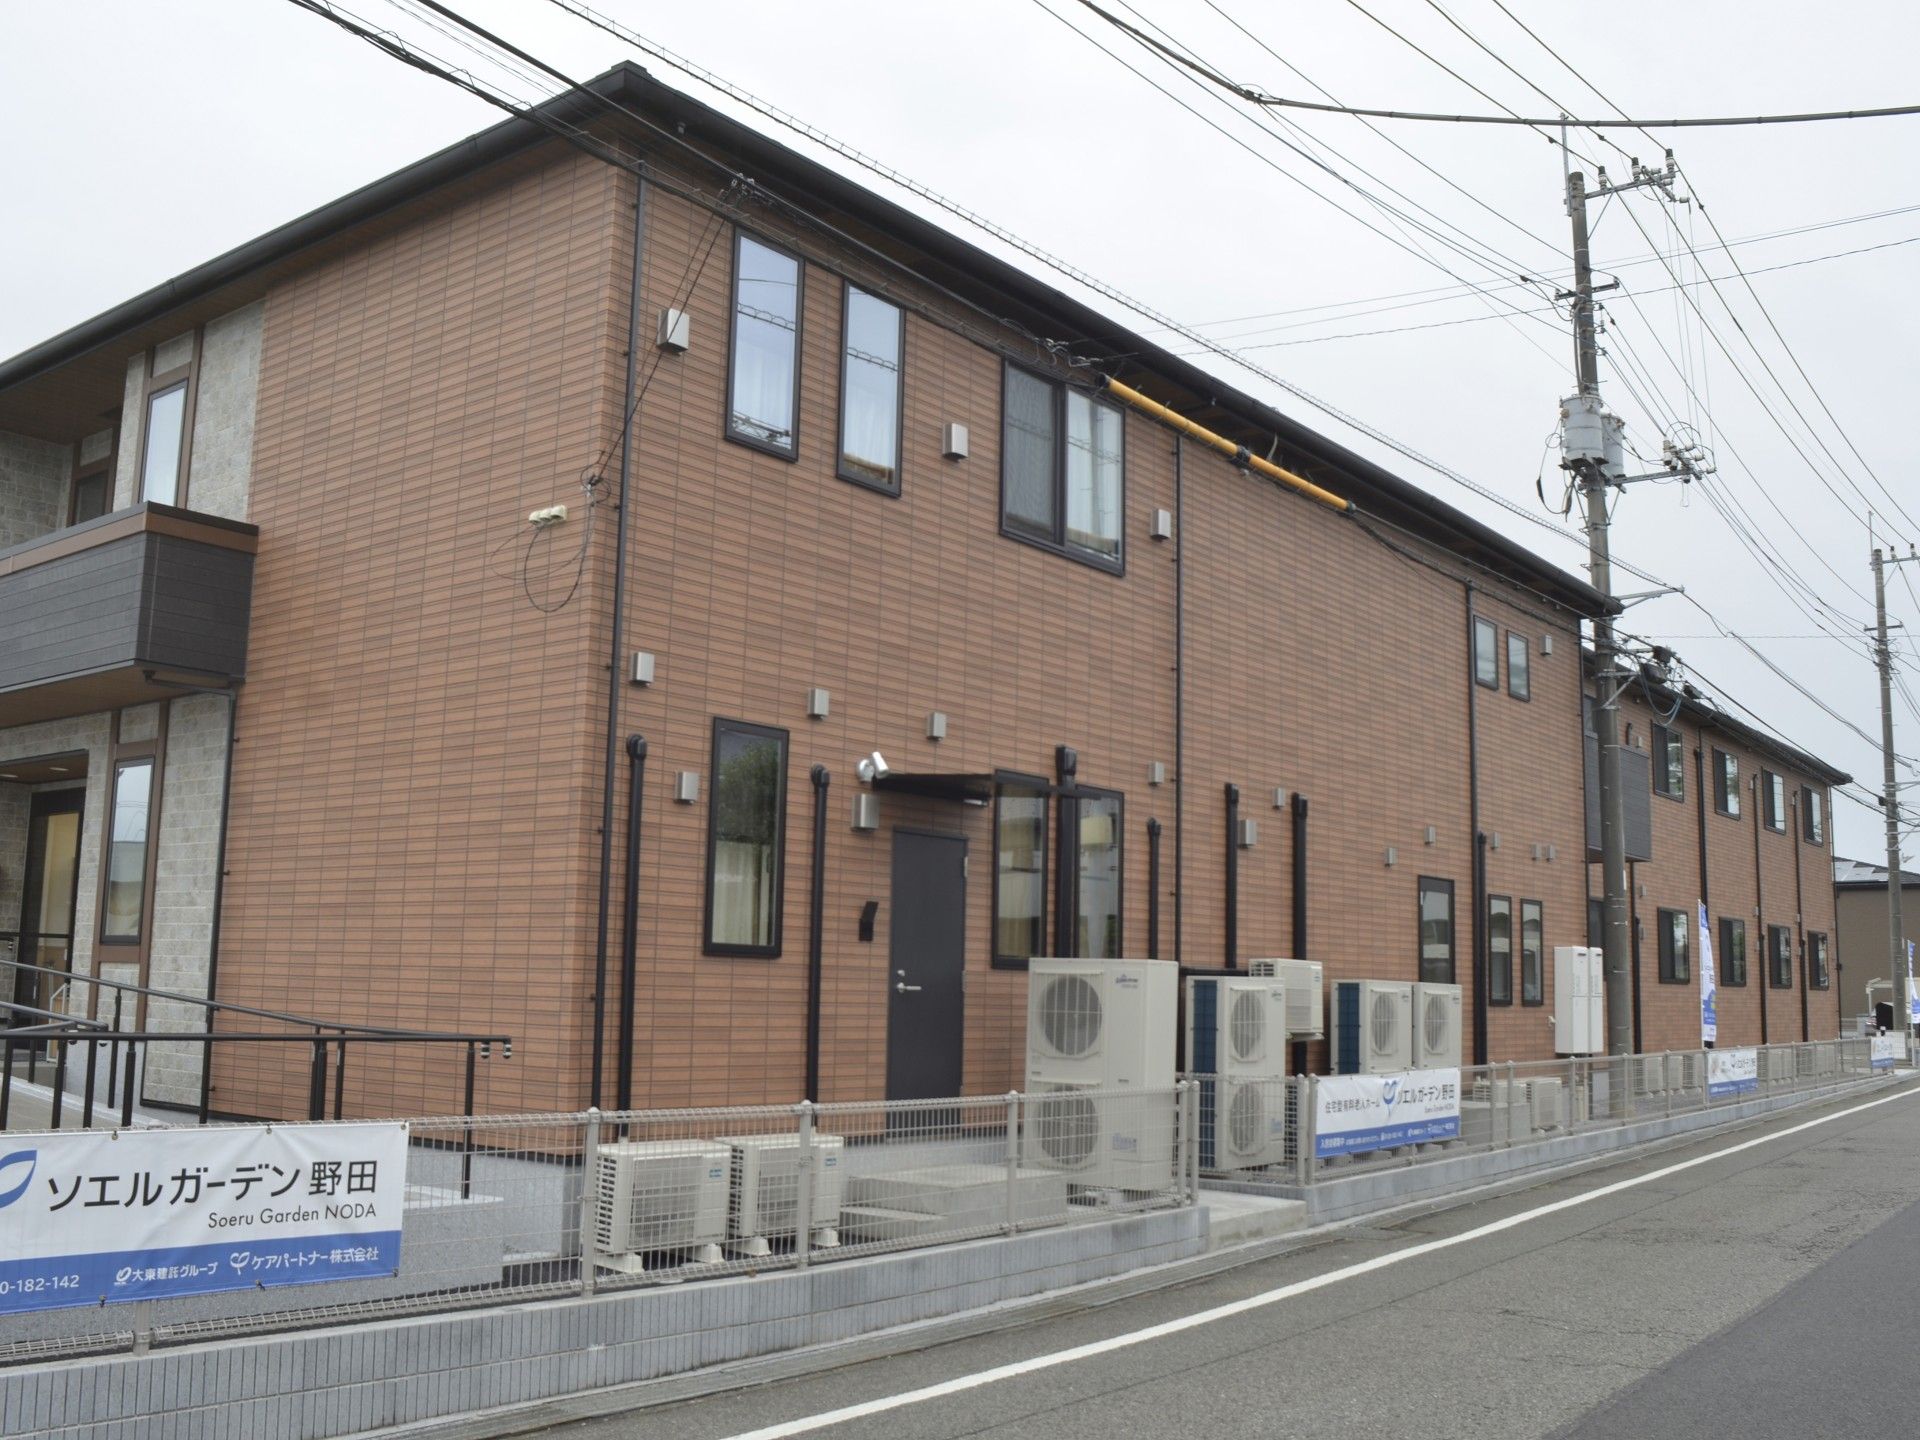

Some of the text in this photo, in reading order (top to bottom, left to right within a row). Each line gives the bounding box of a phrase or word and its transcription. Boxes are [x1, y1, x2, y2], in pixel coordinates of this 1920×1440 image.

[208, 1202, 377, 1229] Soeru Garden NODA
